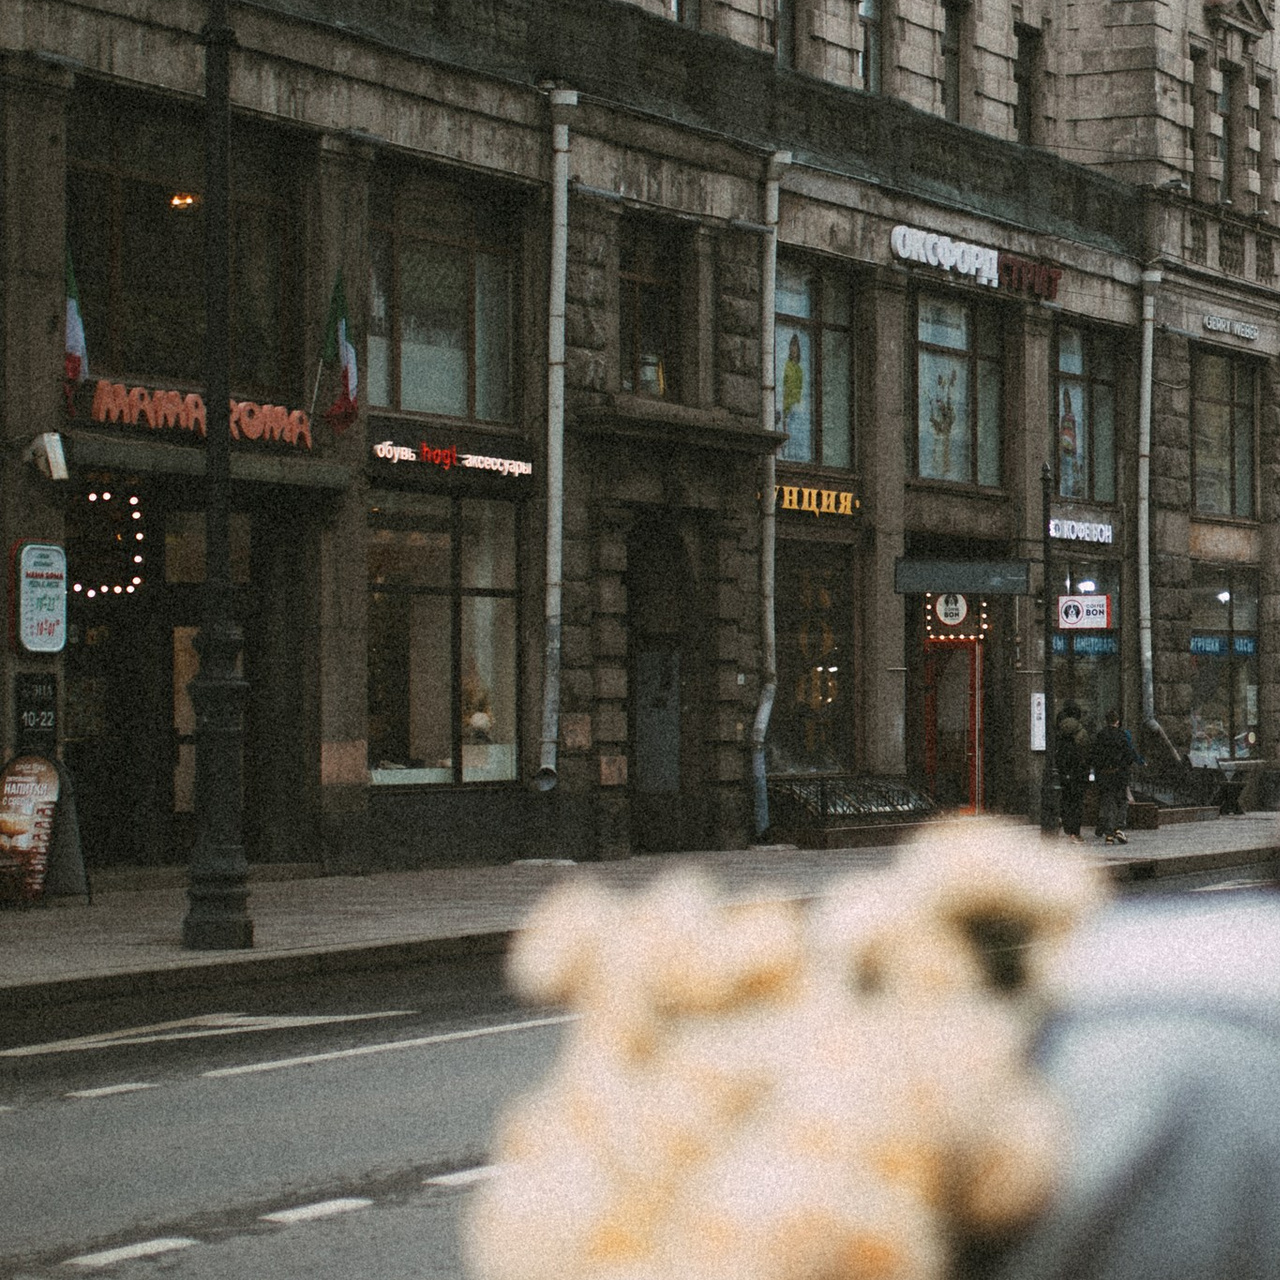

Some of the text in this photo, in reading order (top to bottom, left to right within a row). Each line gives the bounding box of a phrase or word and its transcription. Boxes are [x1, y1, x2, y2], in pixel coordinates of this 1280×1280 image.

[891, 224, 1063, 301] ОКСФОРД СТРИТ
[1204, 315, 1259, 341] GERRY WEBER
[91, 379, 208, 439] MAMA
[373, 440, 417, 464] обувь
[462, 454, 533, 477] аксессуары
[1063, 520, 1113, 544] КОФЕ БОН
[22, 711, 54, 727] 10-22
[4, 782, 48, 796] НАПИТКИ
